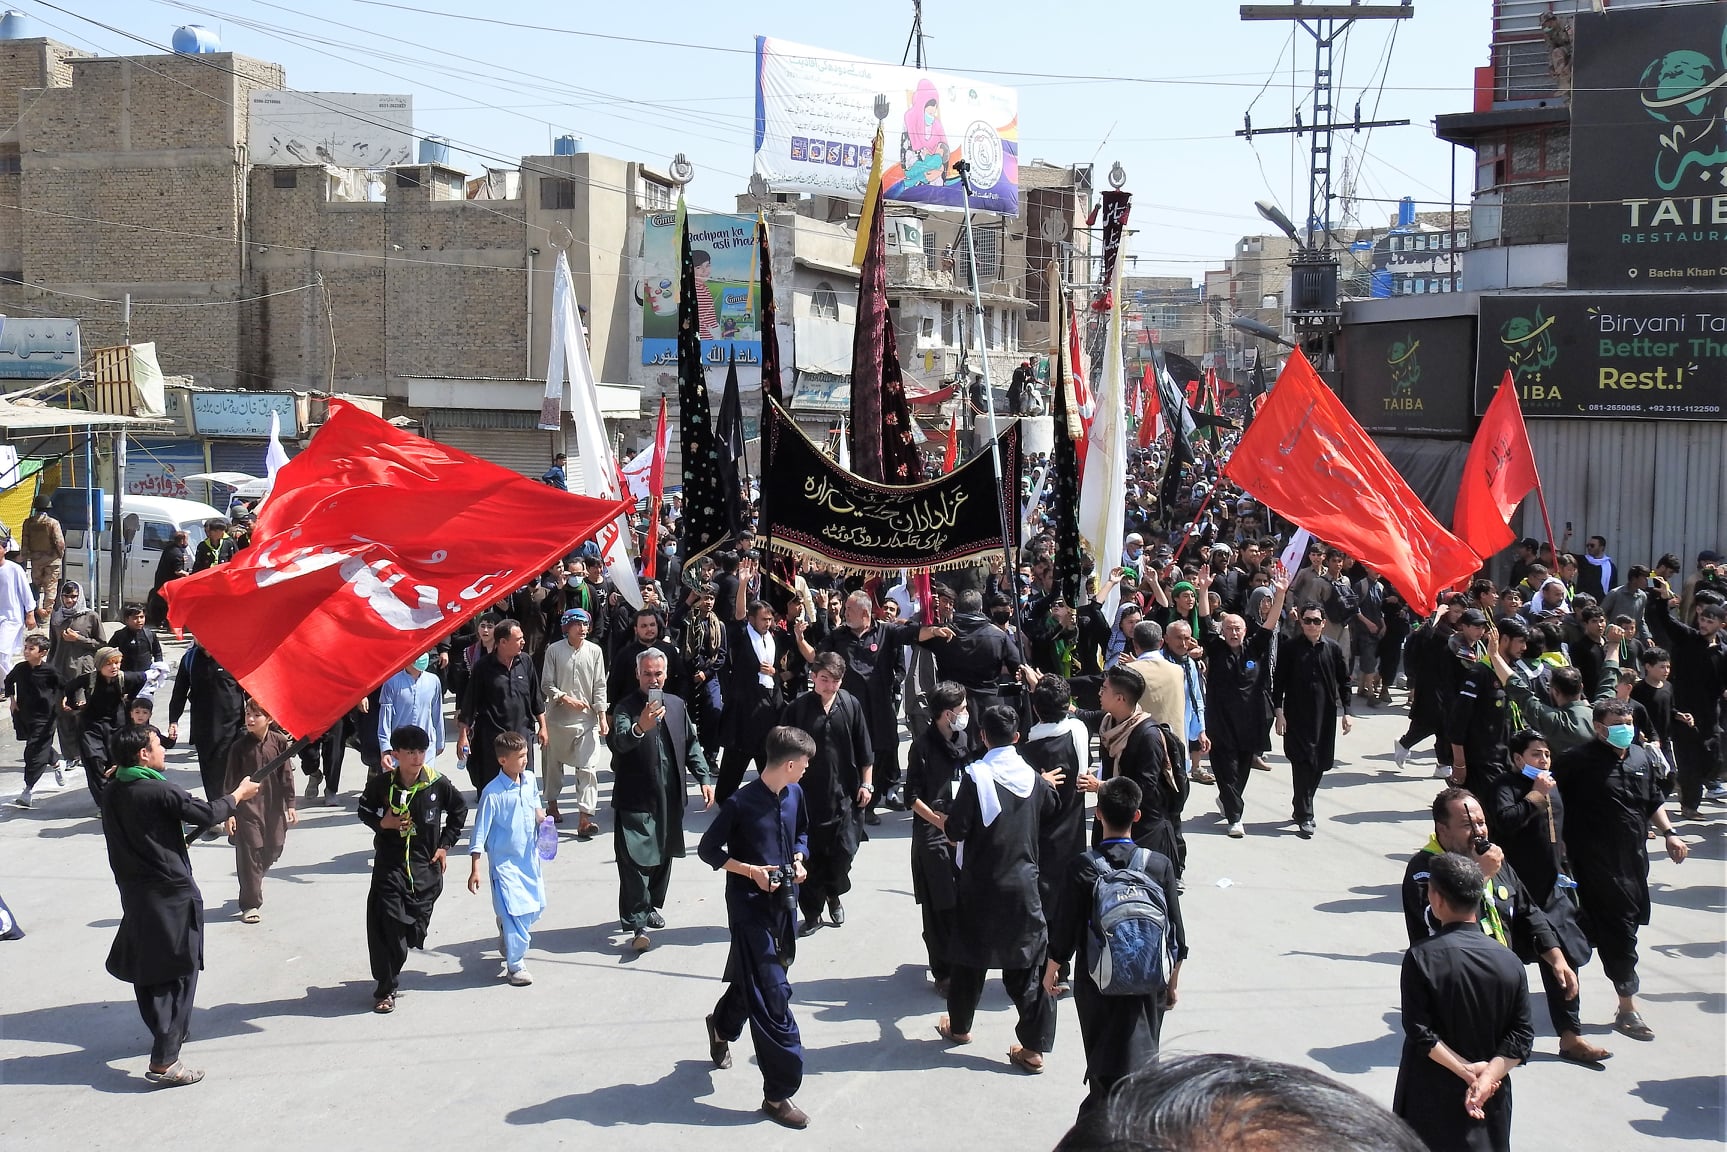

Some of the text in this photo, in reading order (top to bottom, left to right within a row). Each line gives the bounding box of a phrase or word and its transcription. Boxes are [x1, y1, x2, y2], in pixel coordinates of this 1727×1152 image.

[732, 226, 744, 236] ka
[713, 238, 730, 249] asli
[1649, 268, 1684, 278] Bacha
[1687, 267, 1715, 277] Khan
[1600, 313, 1727, 336] Biryani Ta
[1599, 338, 1679, 358] Better
[1599, 366, 1683, 390] Rest.!
[1383, 398, 1424, 410] TAIBA
[1588, 404, 1641, 412] 081-2650065
[1648, 404, 1664, 412] +92
[1666, 404, 1720, 413] 311-1122500
